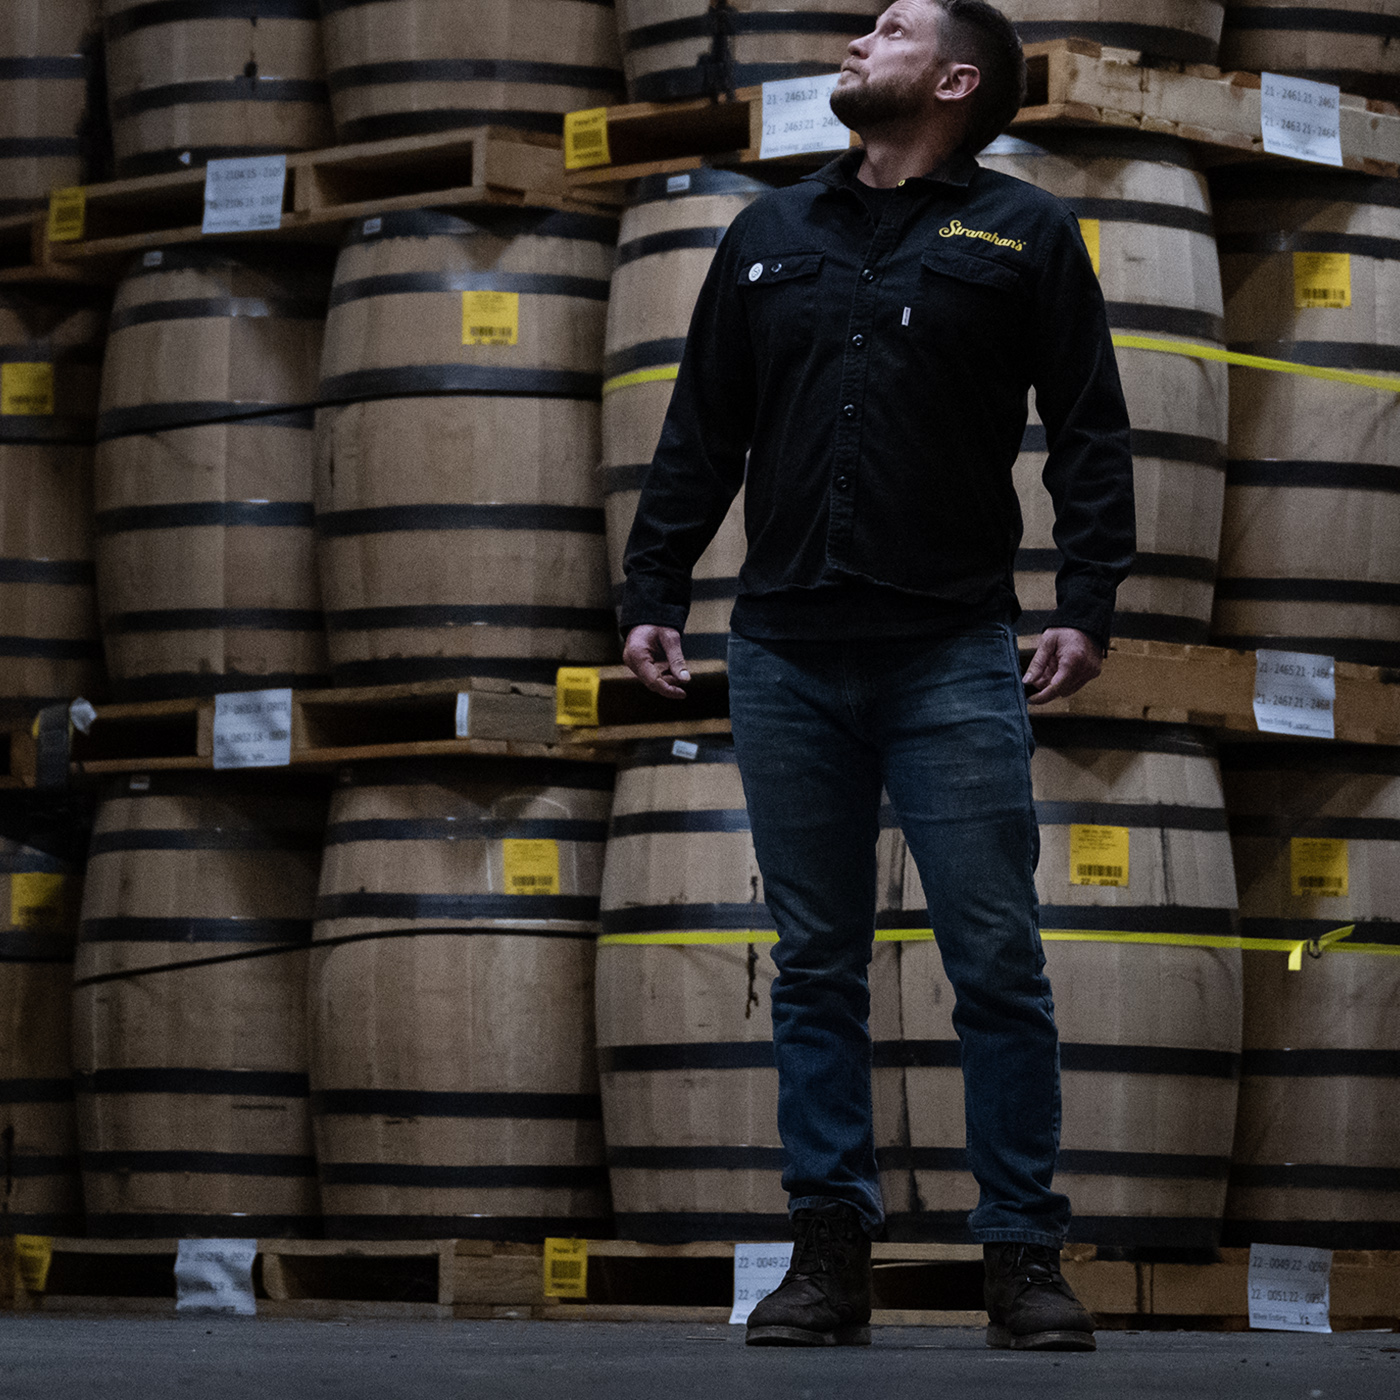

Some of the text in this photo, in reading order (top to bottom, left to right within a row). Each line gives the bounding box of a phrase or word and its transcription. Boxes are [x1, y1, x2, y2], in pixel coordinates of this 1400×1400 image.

[766, 94, 778, 105] 21
[785, 90, 807, 103] 2461
[807, 90, 818, 100] 21
[1264, 85, 1275, 96] 21
[1281, 87, 1301, 101] 2461
[1303, 91, 1312, 104] 21
[766, 124, 775, 136] 21
[784, 120, 803, 133] 2463
[805, 119, 814, 130] 21
[823, 117, 840, 127] 246
[1264, 115, 1274, 126] 21
[1281, 118, 1300, 132] 2463
[1302, 122, 1311, 134] 21
[938, 219, 1023, 252] Stranahan's
[1259, 662, 1268, 673] 21
[1274, 663, 1294, 676] 2465
[1296, 666, 1306, 677] 21
[1256, 693, 1266, 704] 21
[1273, 695, 1293, 706] 2467
[1294, 697, 1304, 708] 21
[738, 1257, 749, 1268] 22
[756, 1257, 777, 1269] 0049
[779, 1257, 789, 1268] 22
[1252, 1256, 1262, 1268] 22
[1269, 1258, 1290, 1269] 0049
[1292, 1259, 1301, 1270] 22
[738, 1289, 748, 1300] 22
[756, 1289, 770, 1298] 00
[1251, 1290, 1261, 1300] 22
[1267, 1290, 1288, 1302] 0051
[1289, 1291, 1298, 1301] 22
